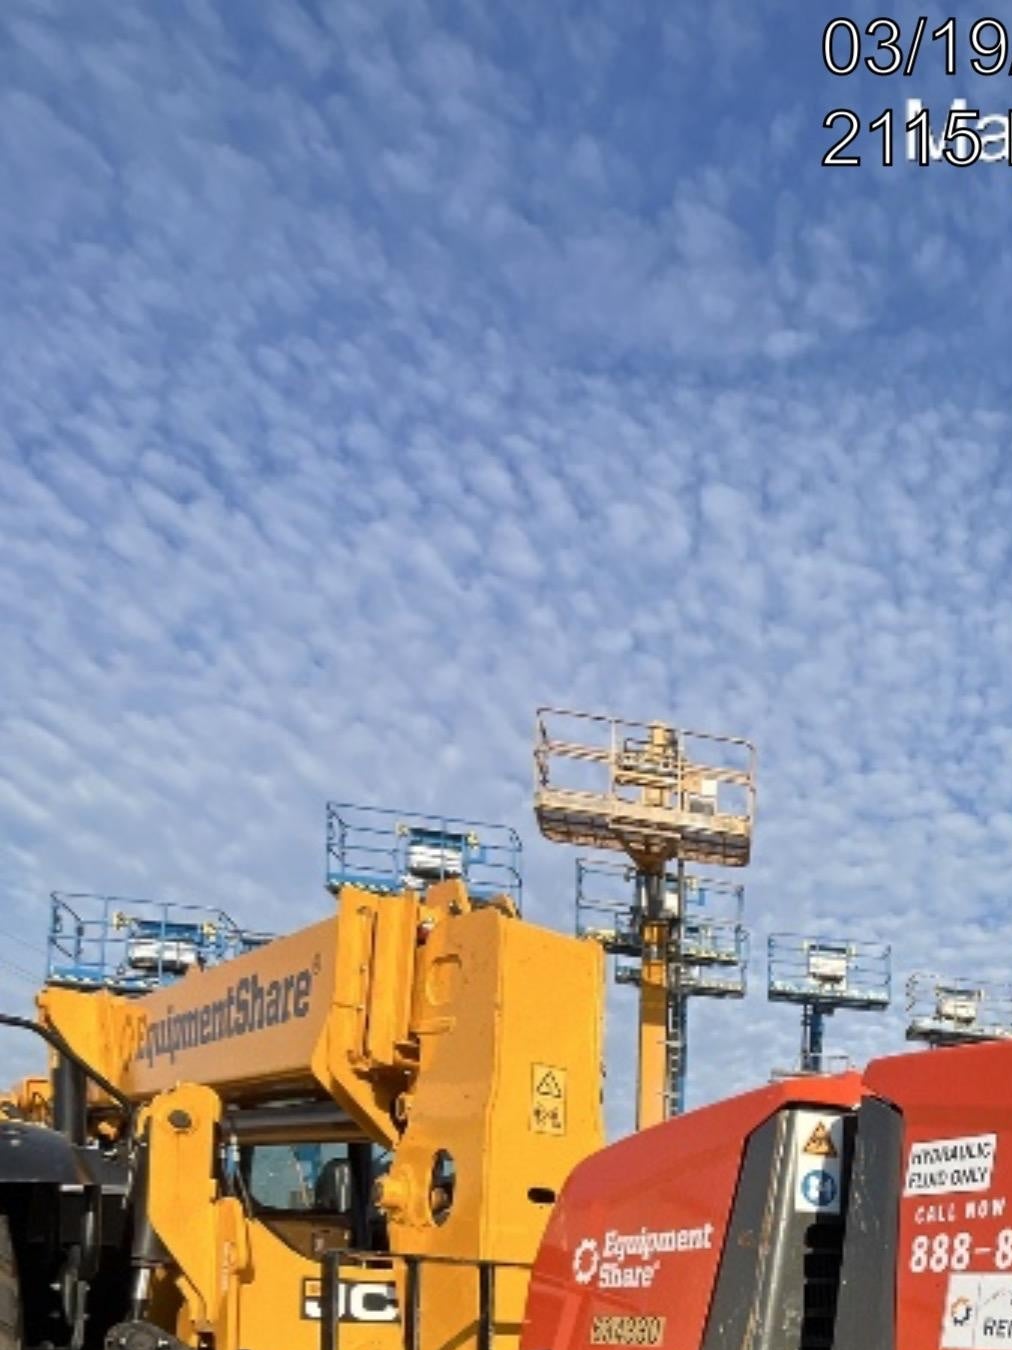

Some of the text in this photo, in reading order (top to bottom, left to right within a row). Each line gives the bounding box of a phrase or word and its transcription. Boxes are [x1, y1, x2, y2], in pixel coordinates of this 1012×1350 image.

[951, 1166, 988, 1186] ONLY
[914, 1196, 1007, 1224] CALL NOW
[602, 1221, 714, 1262] Equipment
